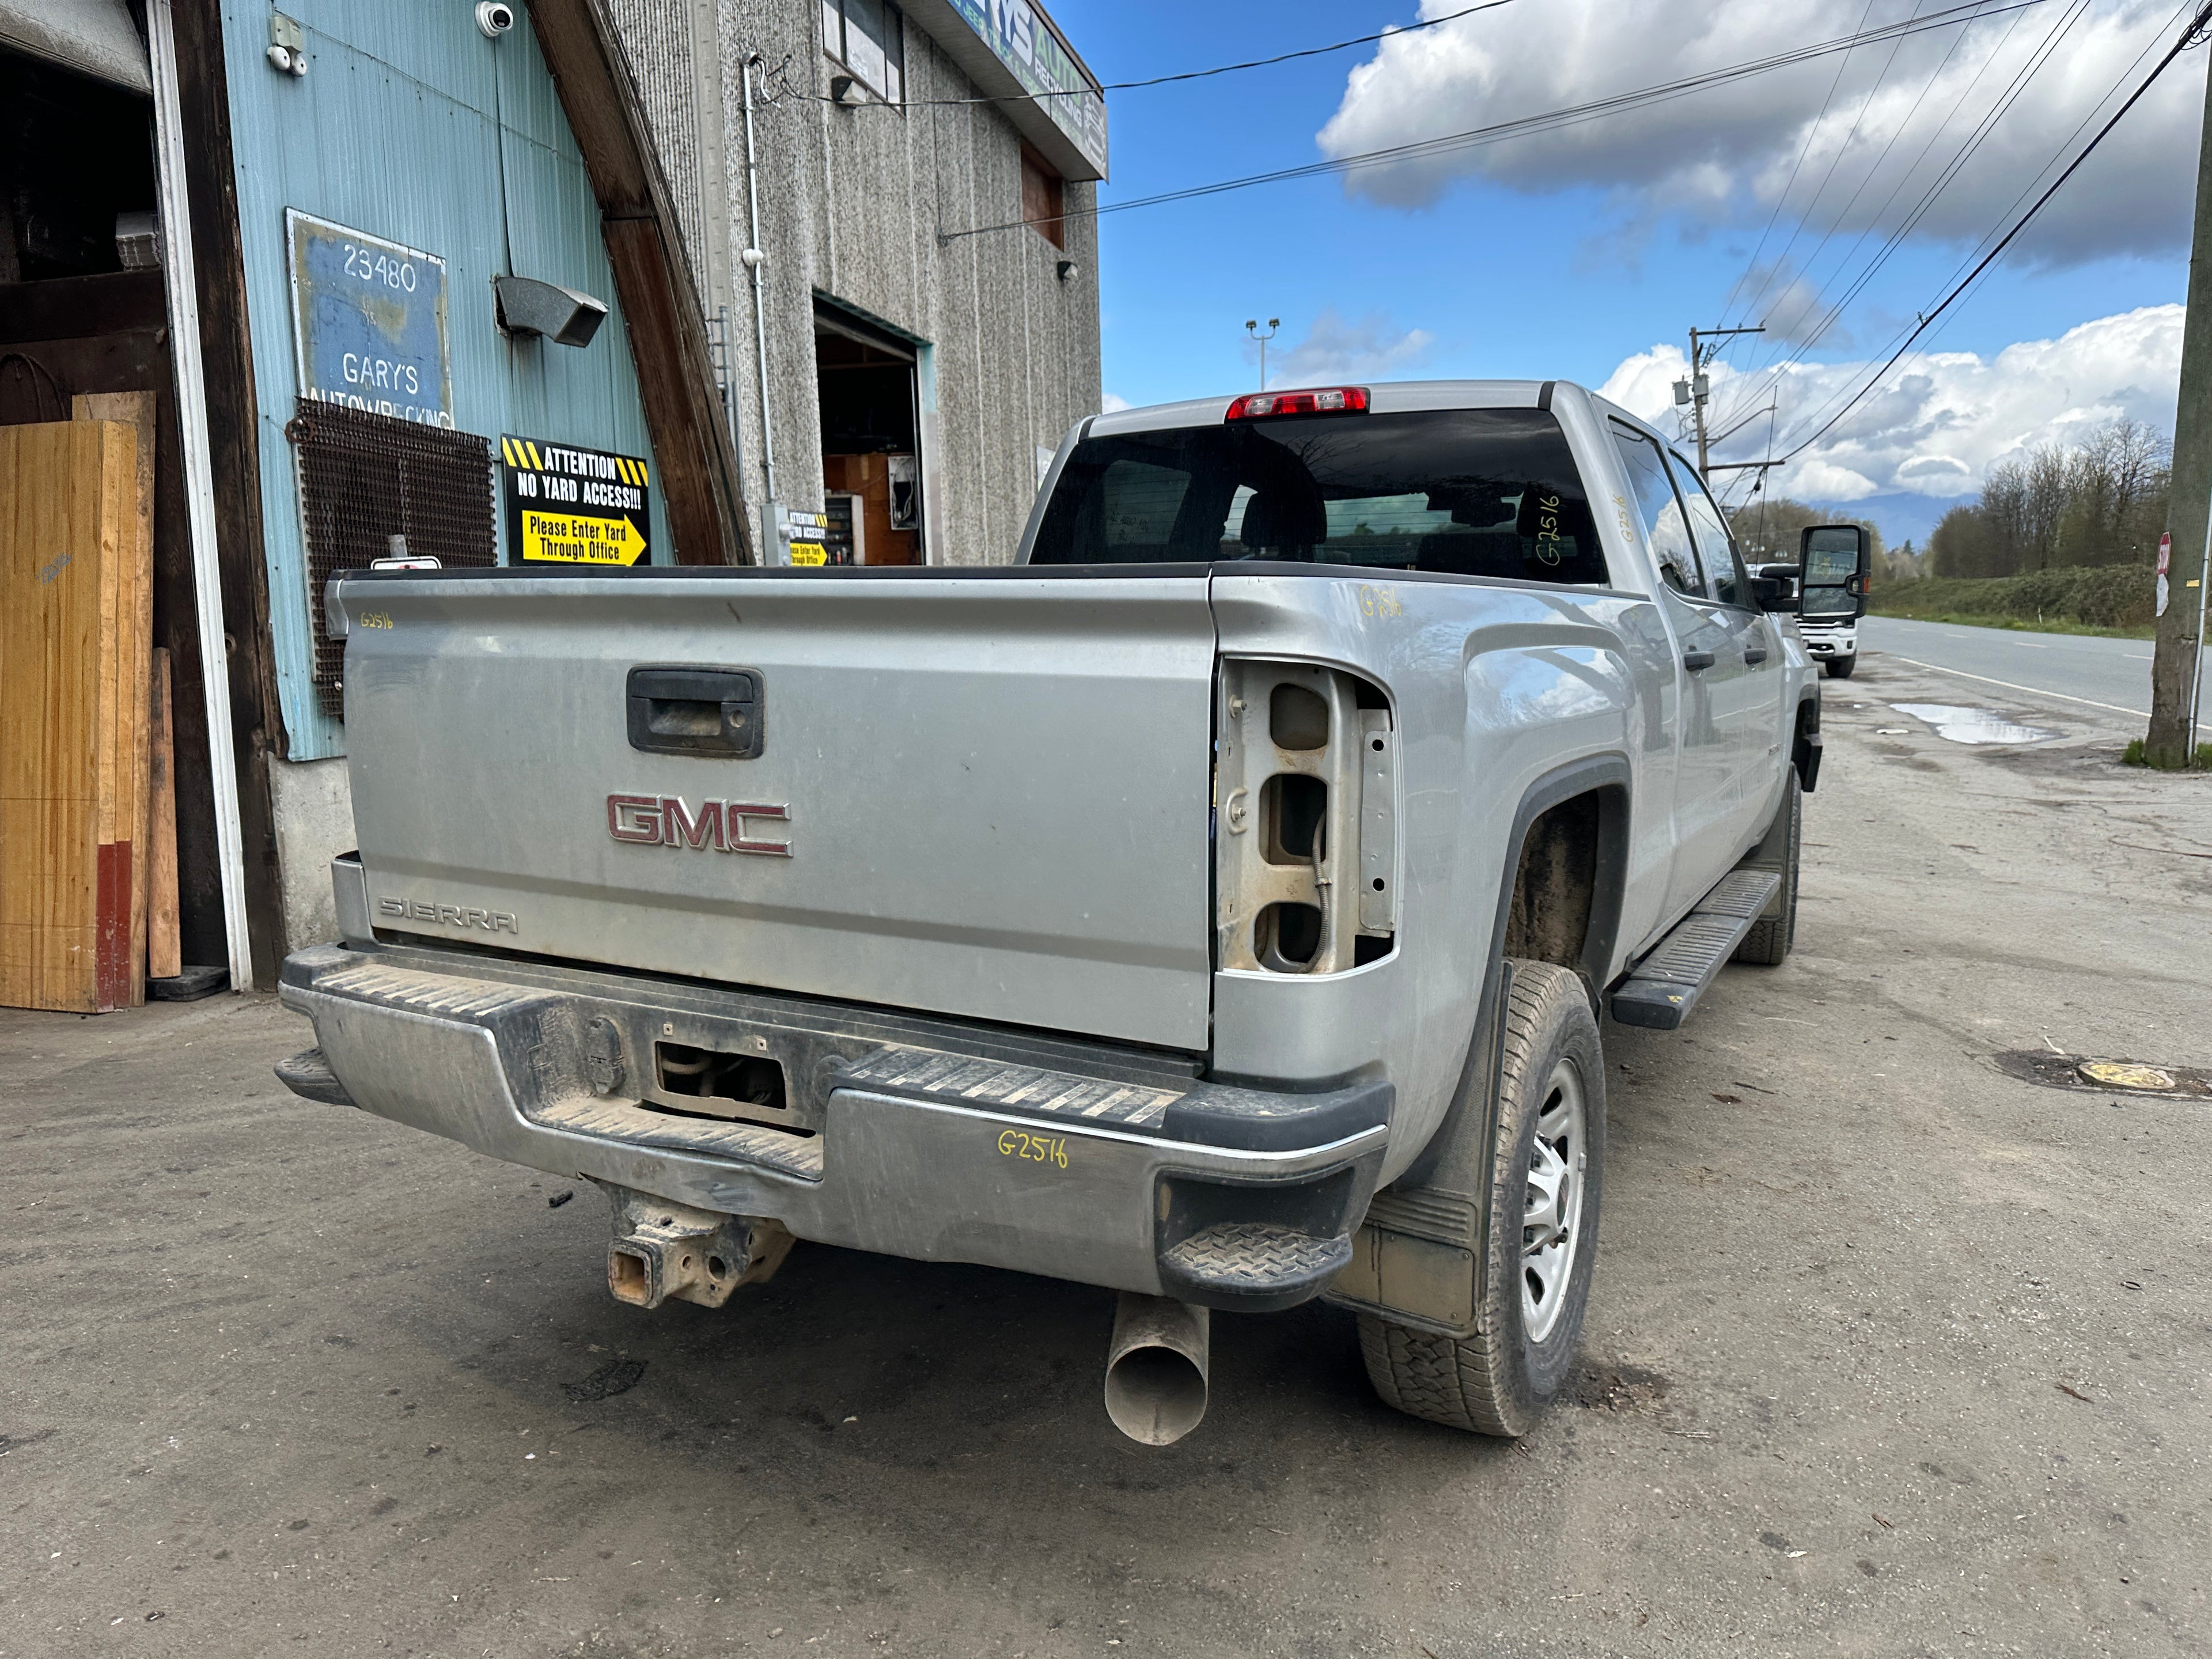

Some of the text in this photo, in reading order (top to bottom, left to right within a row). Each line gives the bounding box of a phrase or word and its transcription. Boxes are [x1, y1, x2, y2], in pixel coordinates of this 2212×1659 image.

[1035, 25, 1081, 107] AUTO
[1035, 56, 1082, 128] RECYCLING
[343, 244, 416, 292] 23480
[343, 353, 418, 394] GARY'S
[544, 446, 616, 480] ATTENTION
[517, 472, 641, 510] NO YARD ACCESS!!!
[530, 516, 626, 541] Please Enter Yard
[790, 512, 816, 525] ATTENTION
[1536, 495, 1560, 566] G2516
[1613, 494, 1634, 543] G2516
[540, 537, 619, 560] Through Office
[361, 611, 393, 630] G2516
[607, 791, 794, 857] GMC
[378, 896, 518, 934] SIERRA
[998, 1130, 1069, 1169] G2516
